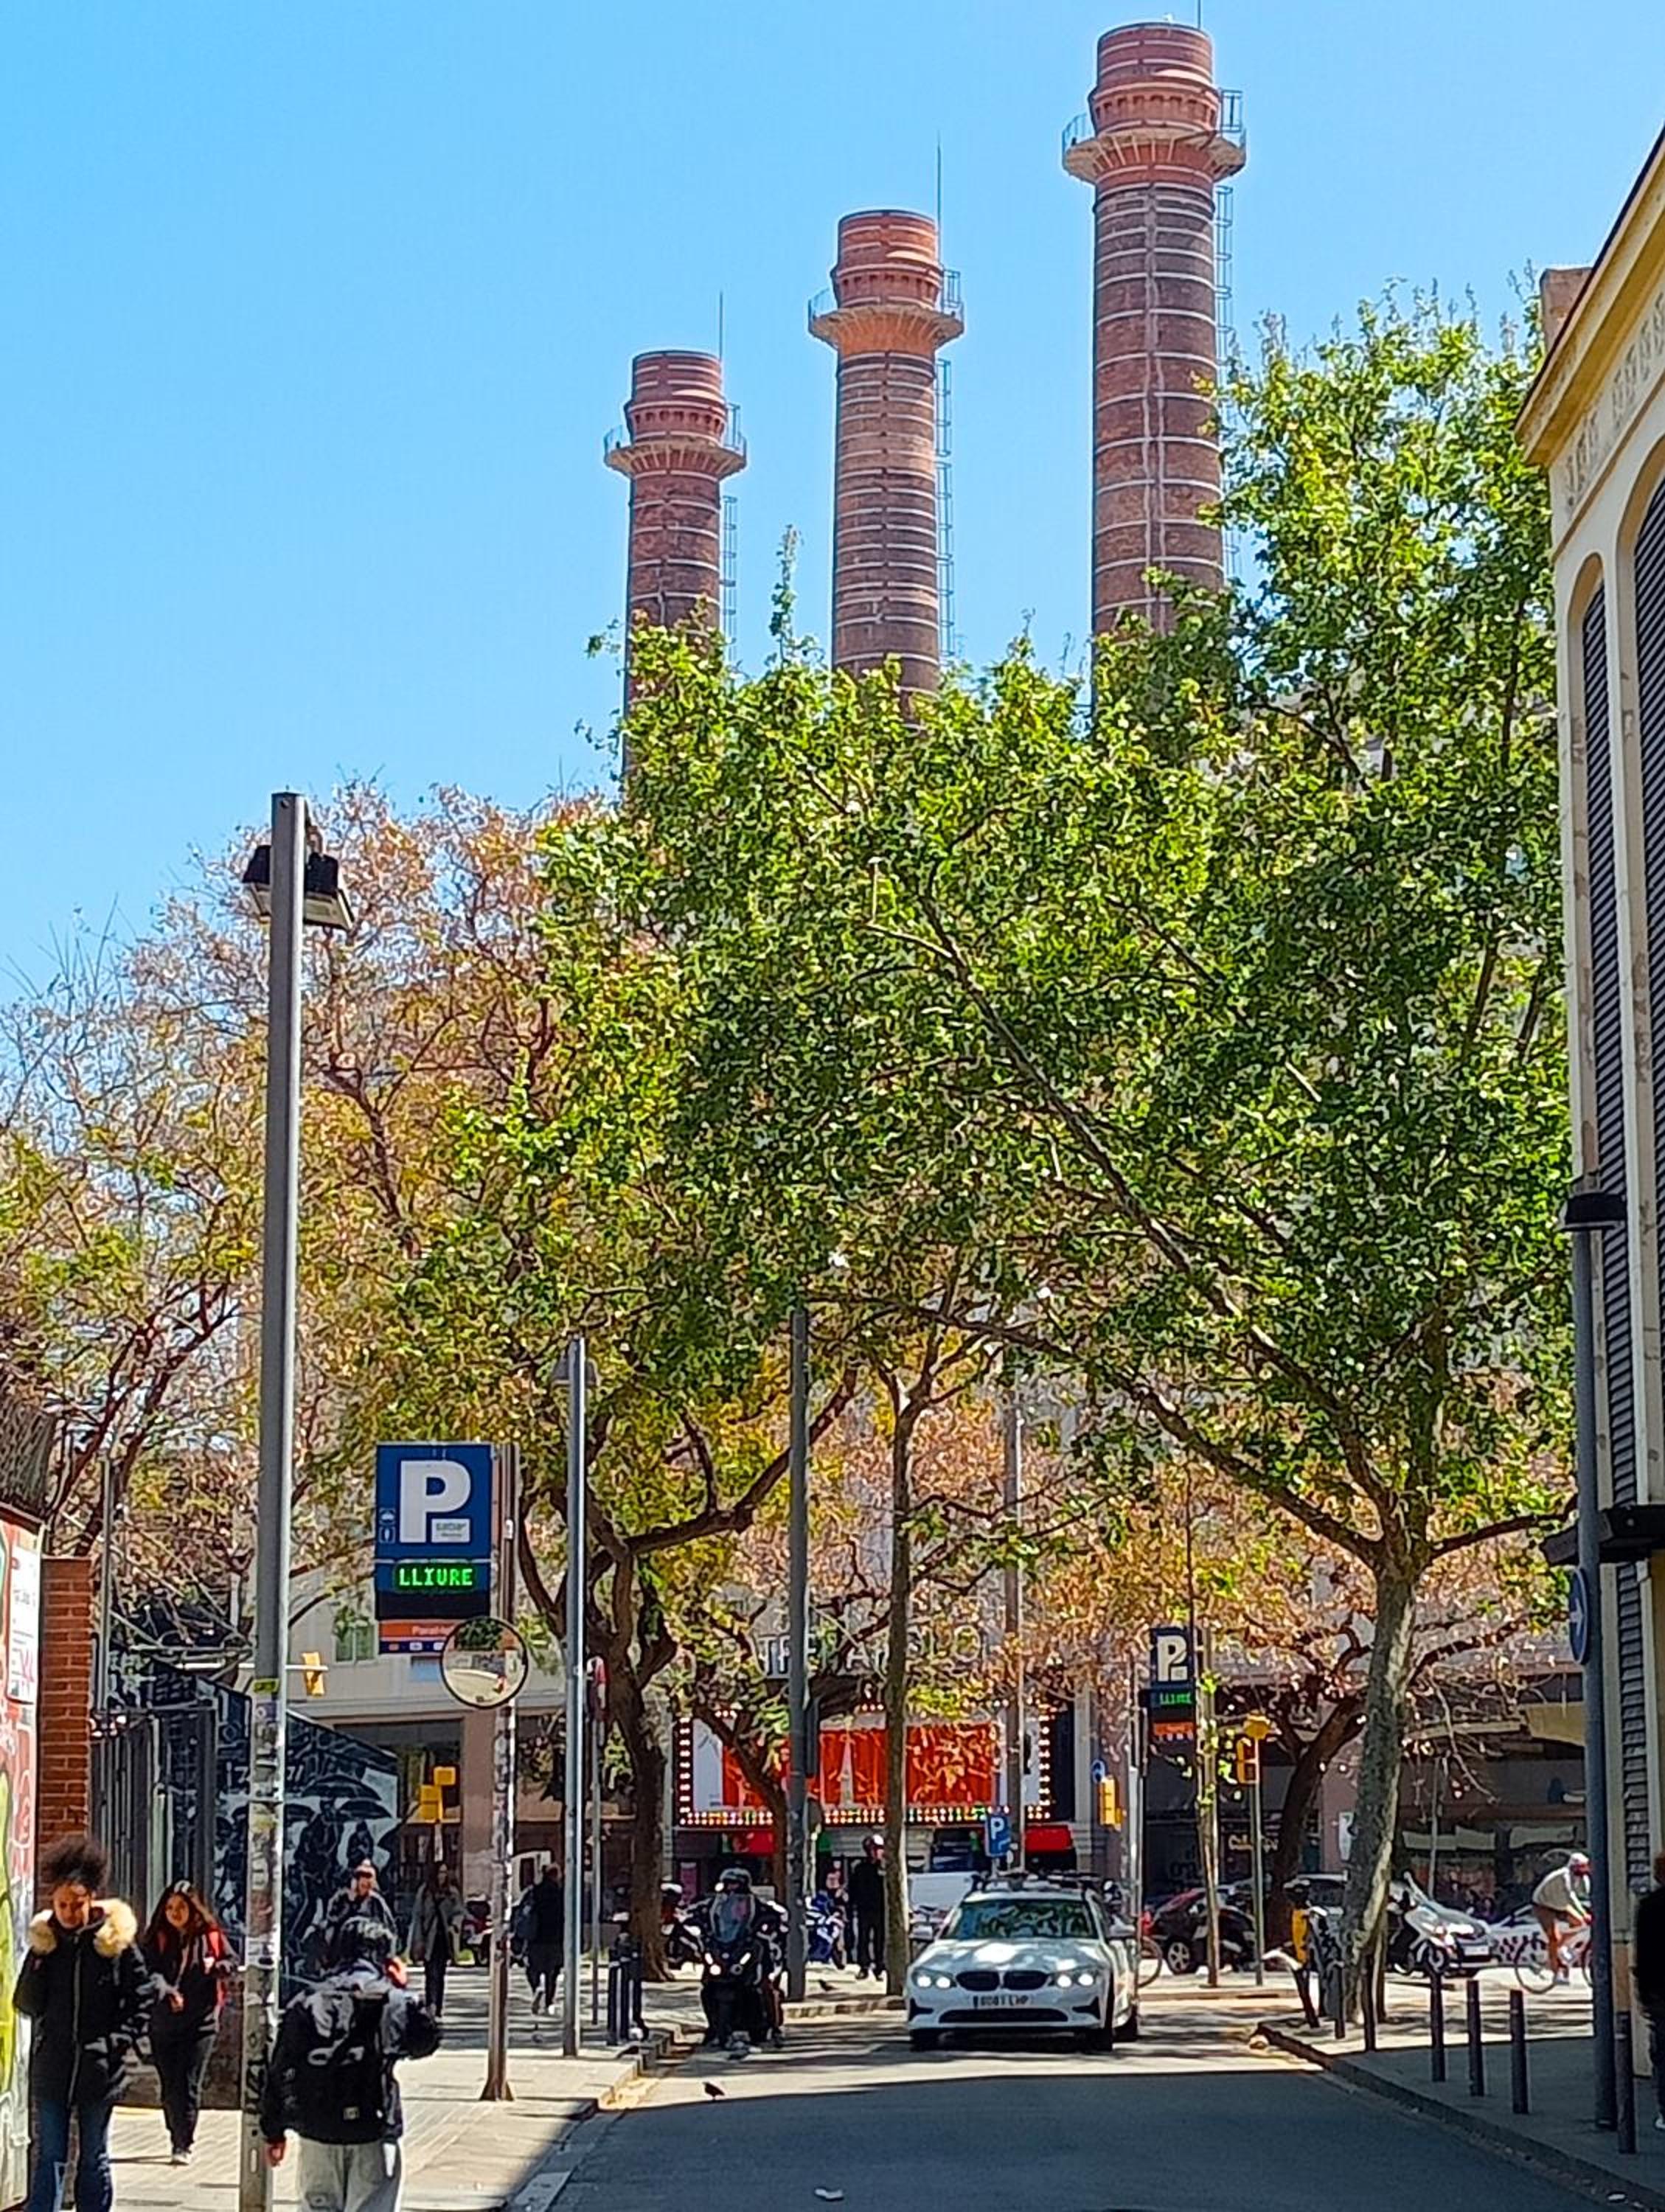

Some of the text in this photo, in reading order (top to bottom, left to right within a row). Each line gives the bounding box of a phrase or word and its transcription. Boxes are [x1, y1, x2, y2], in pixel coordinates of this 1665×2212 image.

[399, 1459, 471, 1543] P
[398, 1568, 473, 1586] LLIURE
[1157, 1635, 1188, 1682] P
[990, 1817, 1005, 1840] P
